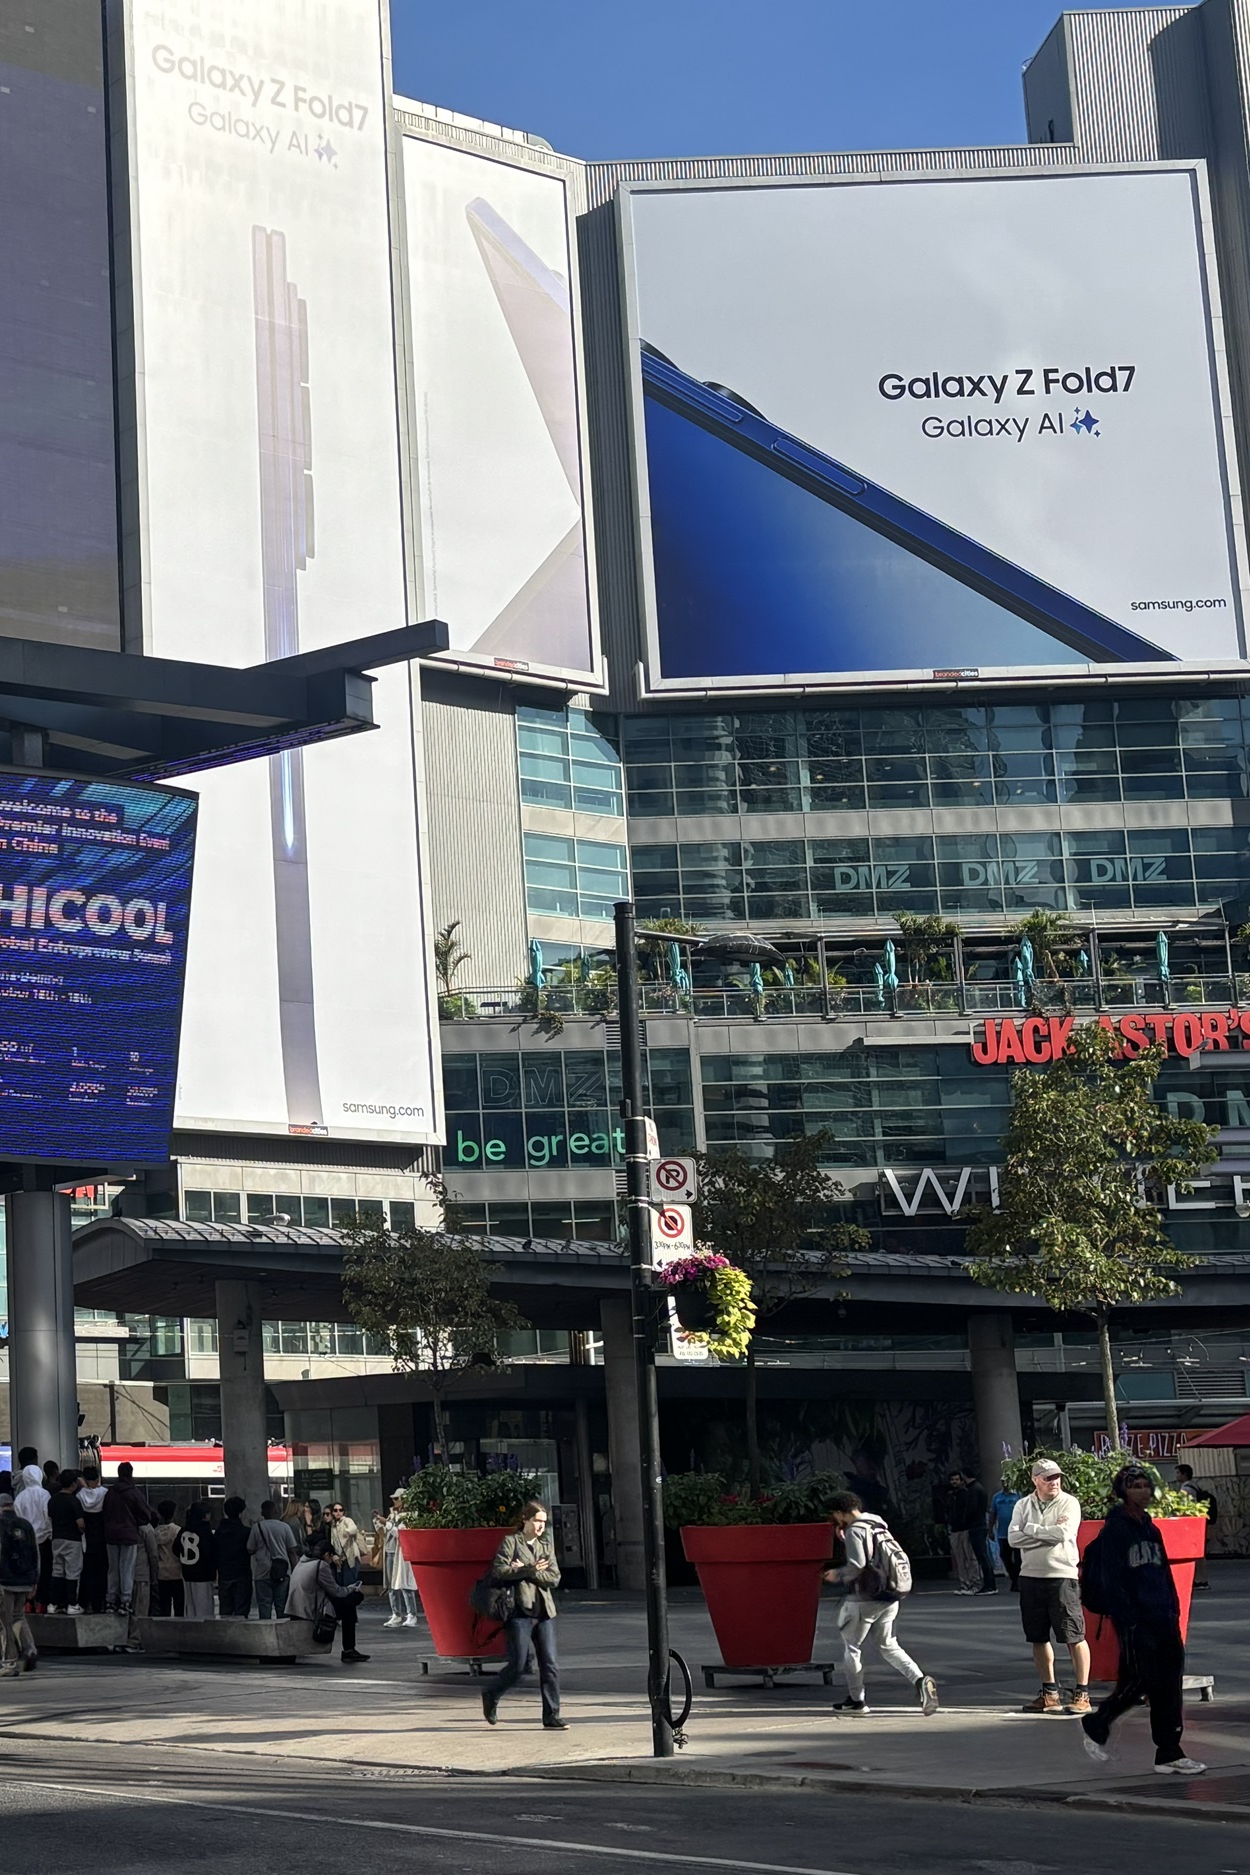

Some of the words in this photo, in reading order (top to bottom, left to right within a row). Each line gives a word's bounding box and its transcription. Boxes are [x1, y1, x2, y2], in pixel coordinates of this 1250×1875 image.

[152, 44, 264, 108] Galaxy
[270, 78, 286, 108] Z
[293, 84, 368, 132] Fold7
[188, 102, 280, 154] Galaxy
[288, 130, 308, 156] AI
[878, 371, 1009, 404] Galaxy
[1015, 369, 1035, 396] Z
[1043, 365, 1136, 395] Fold7
[921, 414, 1030, 442] Galaxy
[1038, 412, 1064, 435] AI
[1130, 597, 1227, 613] samsung.com
[834, 865, 911, 891] DMZ
[962, 860, 1039, 886] DMZ
[1090, 857, 1168, 883] DMZ
[973, 1016, 1077, 1065] JACK
[481, 1067, 606, 1106] DMZ
[342, 1102, 425, 1119] samsung.com
[457, 1130, 507, 1162] be
[527, 1128, 626, 1166] great
[1149, 1432, 1188, 1458] PIZZA
